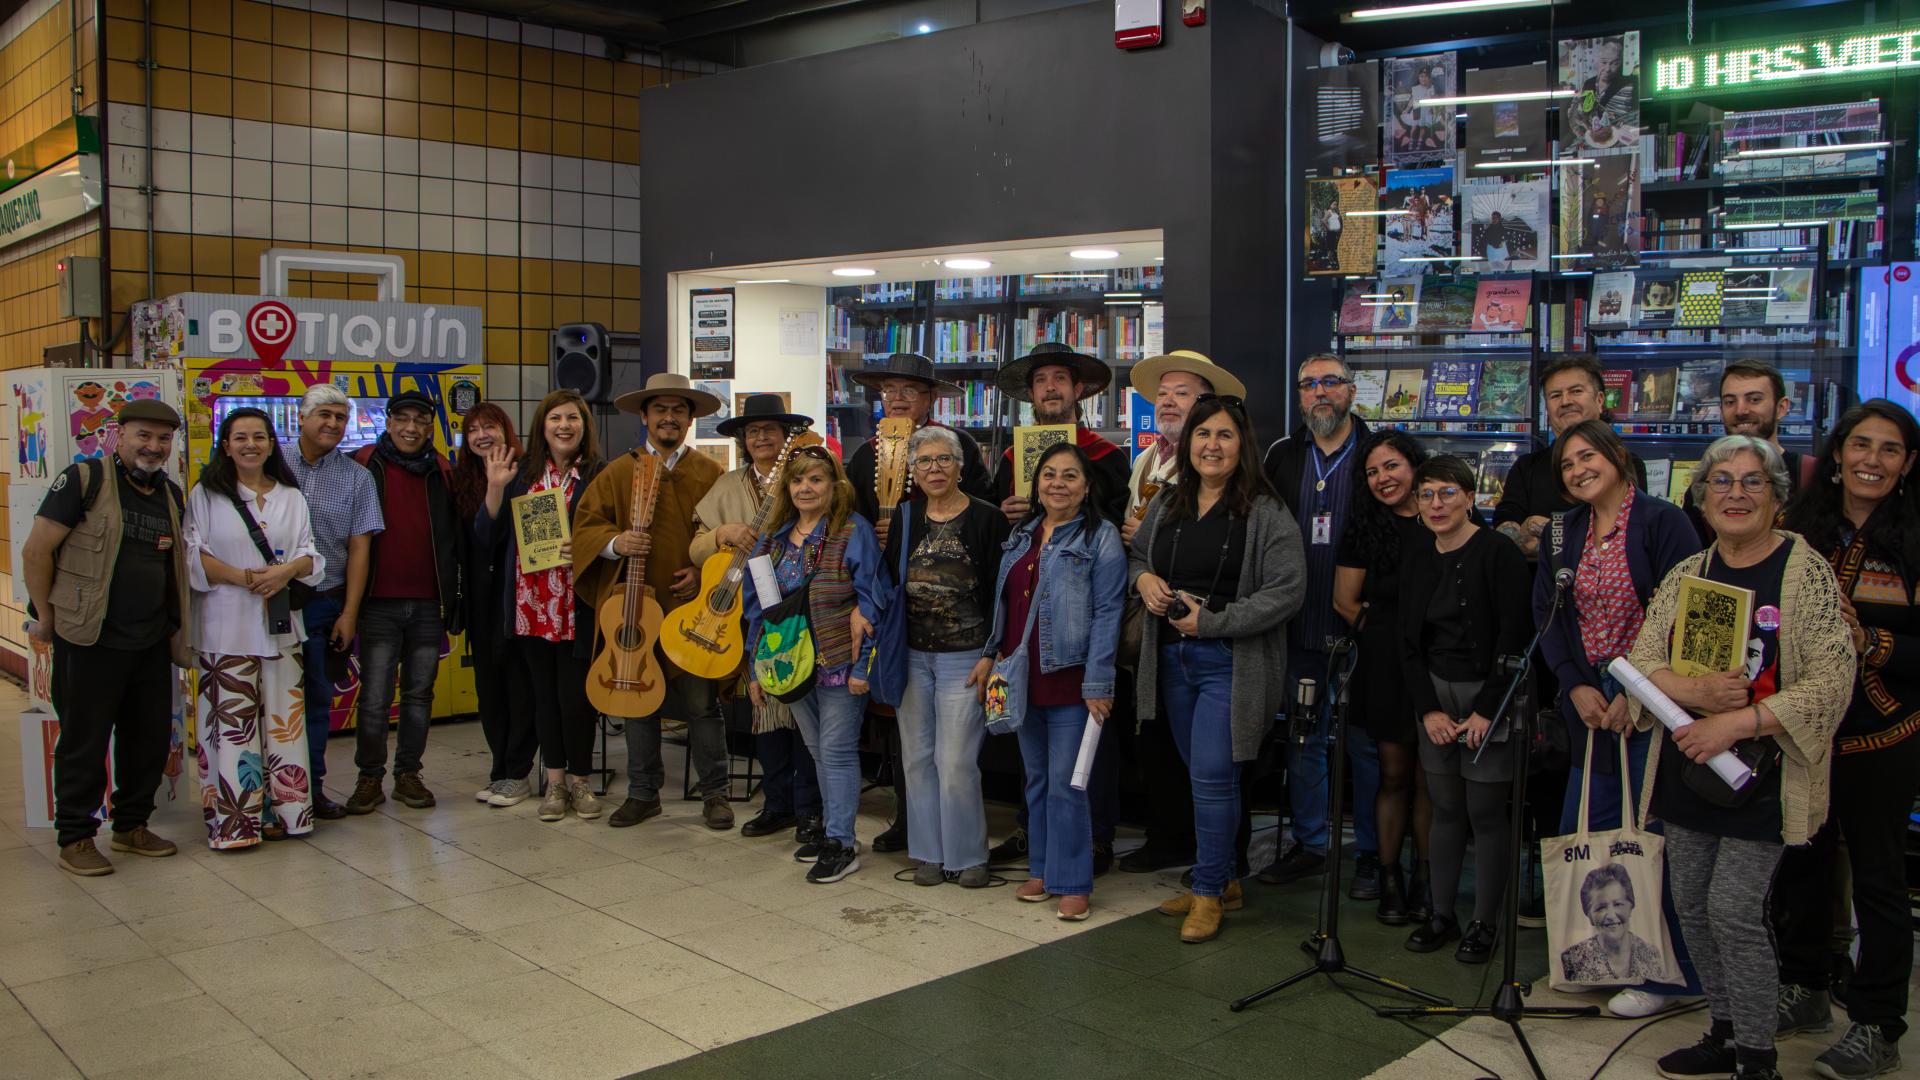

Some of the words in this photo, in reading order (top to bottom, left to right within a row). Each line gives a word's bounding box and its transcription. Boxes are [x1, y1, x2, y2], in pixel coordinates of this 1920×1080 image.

[0, 188, 41, 236] AQUEDANO
[1552, 512, 1564, 556] BUBBA
[1564, 844, 1591, 862] 8M
